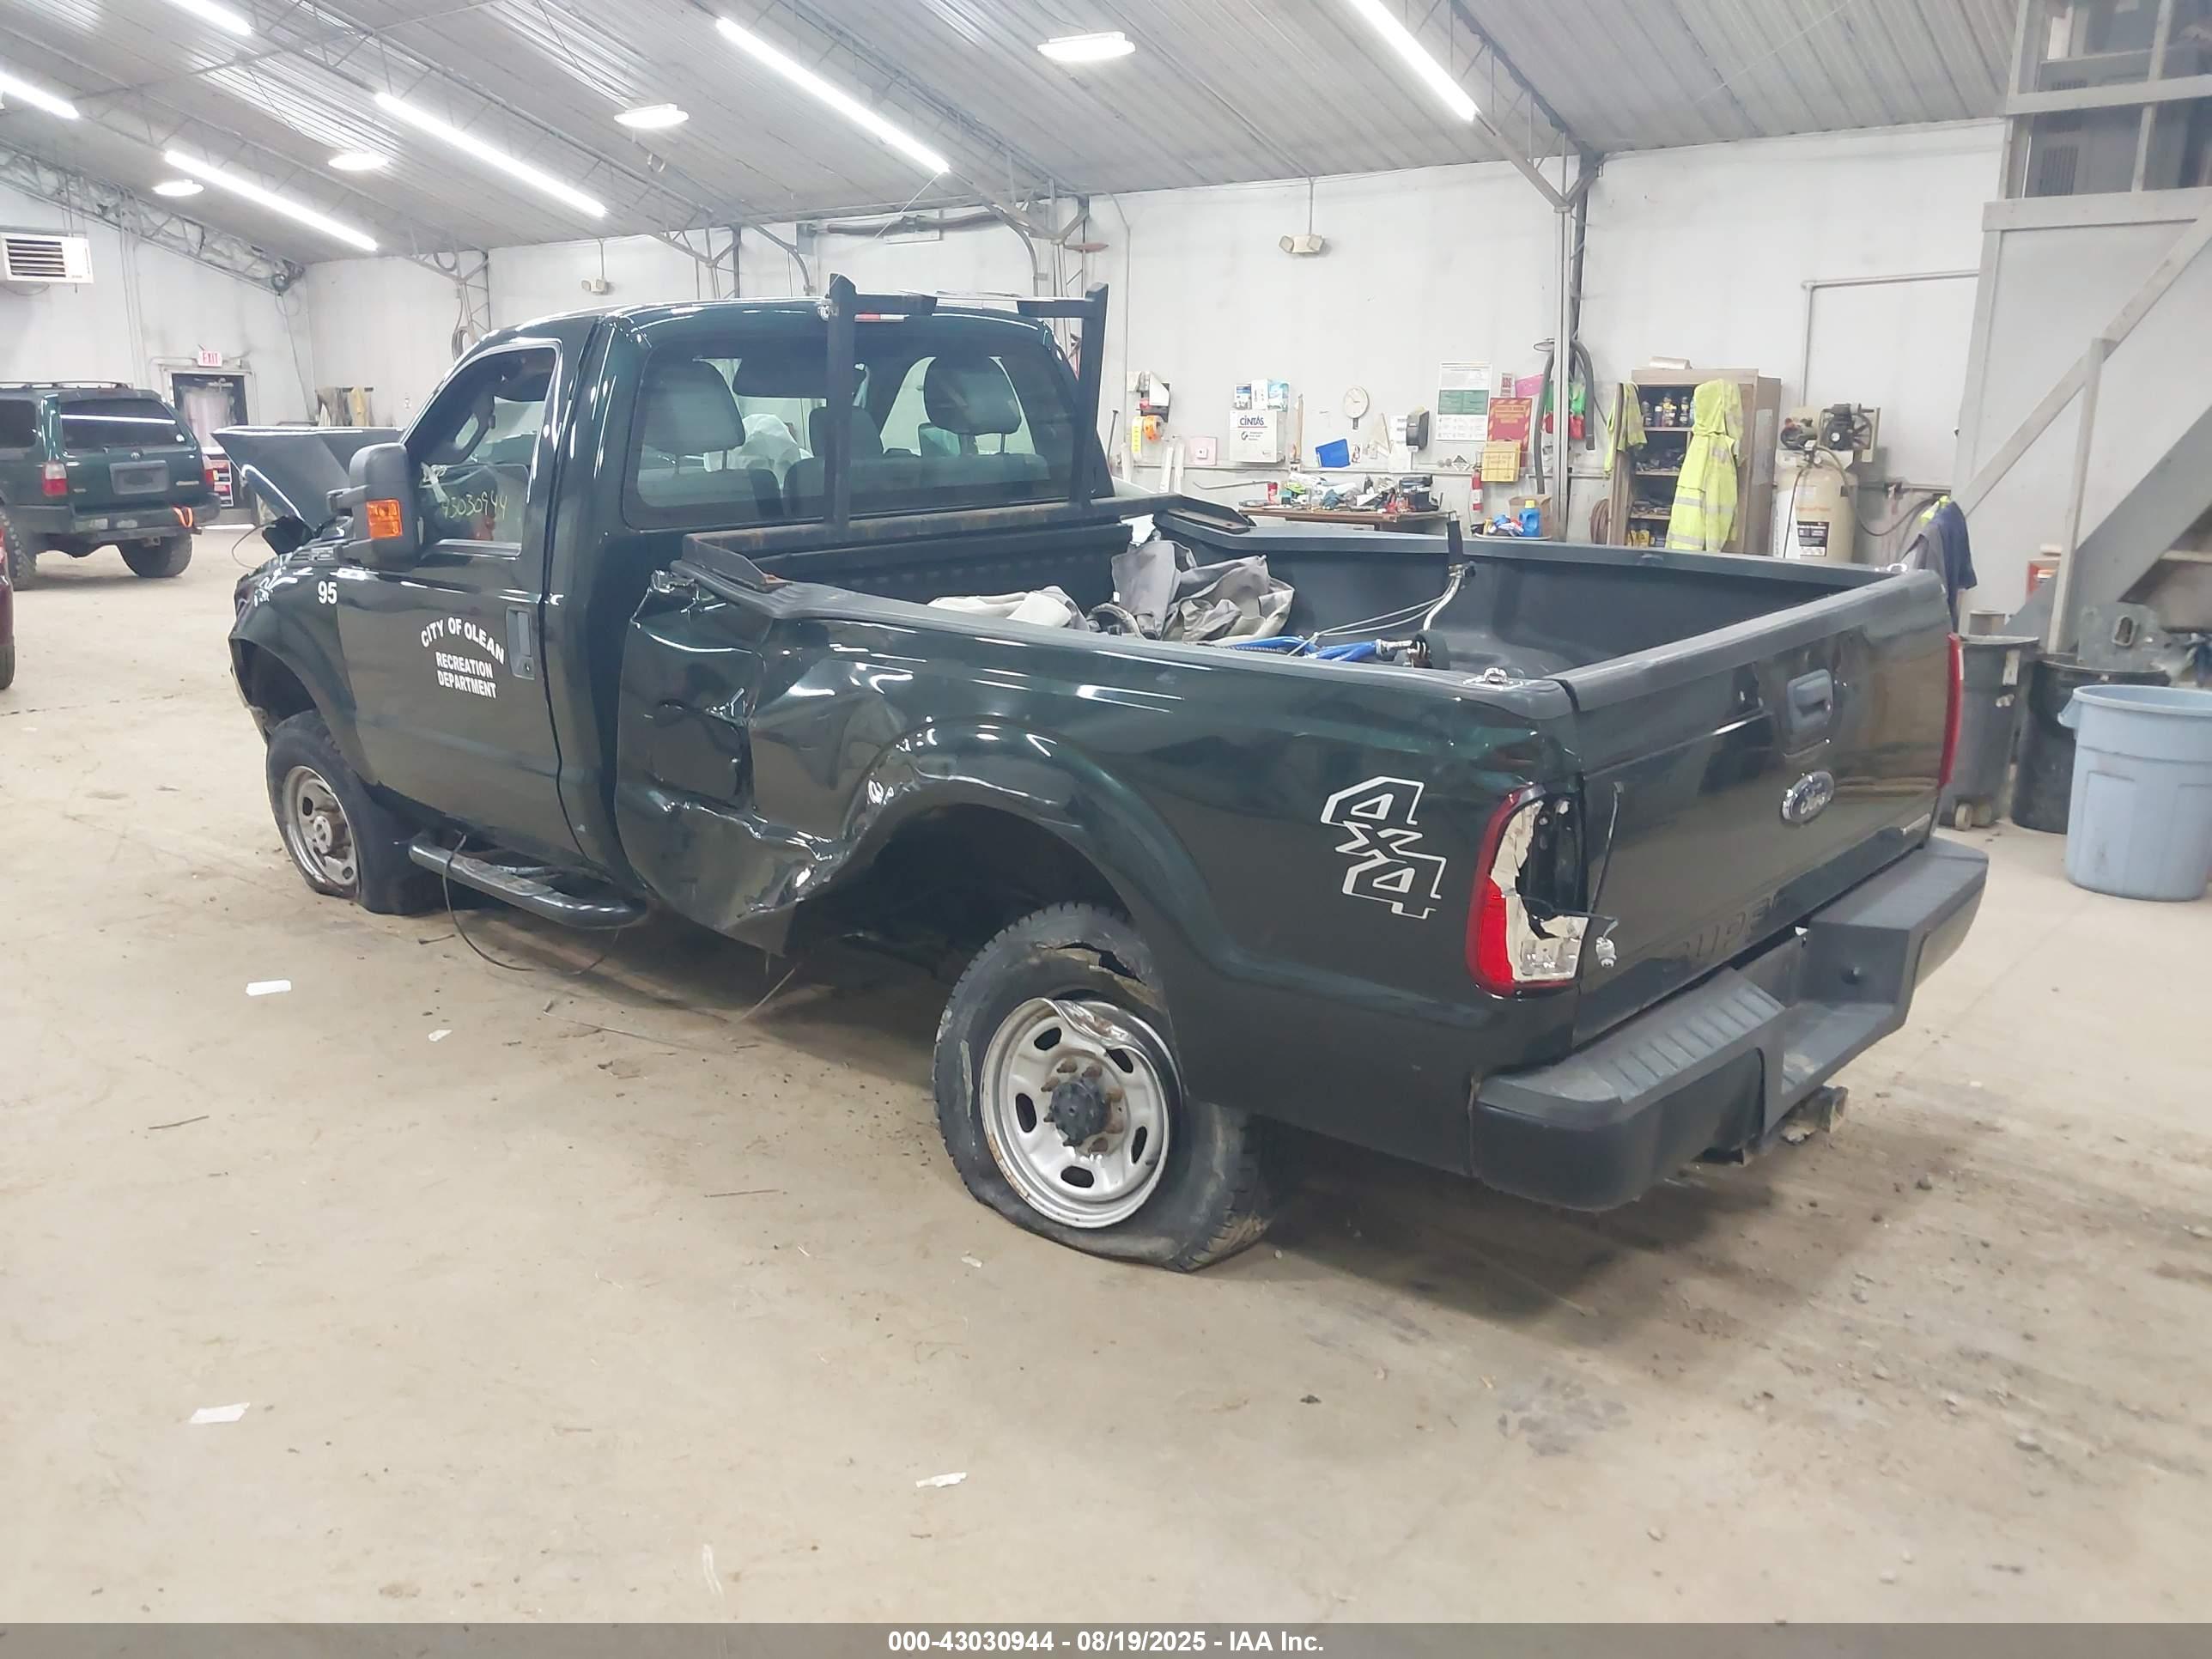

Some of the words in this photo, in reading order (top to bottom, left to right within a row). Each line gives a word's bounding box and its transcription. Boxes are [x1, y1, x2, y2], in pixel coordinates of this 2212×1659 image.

[202, 352, 218, 365] EXIT
[1239, 416, 1265, 426] CINTAS
[318, 580, 337, 605] 95
[421, 619, 444, 647] CITY
[448, 617, 462, 635] OF
[464, 622, 505, 665] OLEAN
[435, 651, 494, 679] RECREATION
[436, 670, 497, 699] DEPARTMENT
